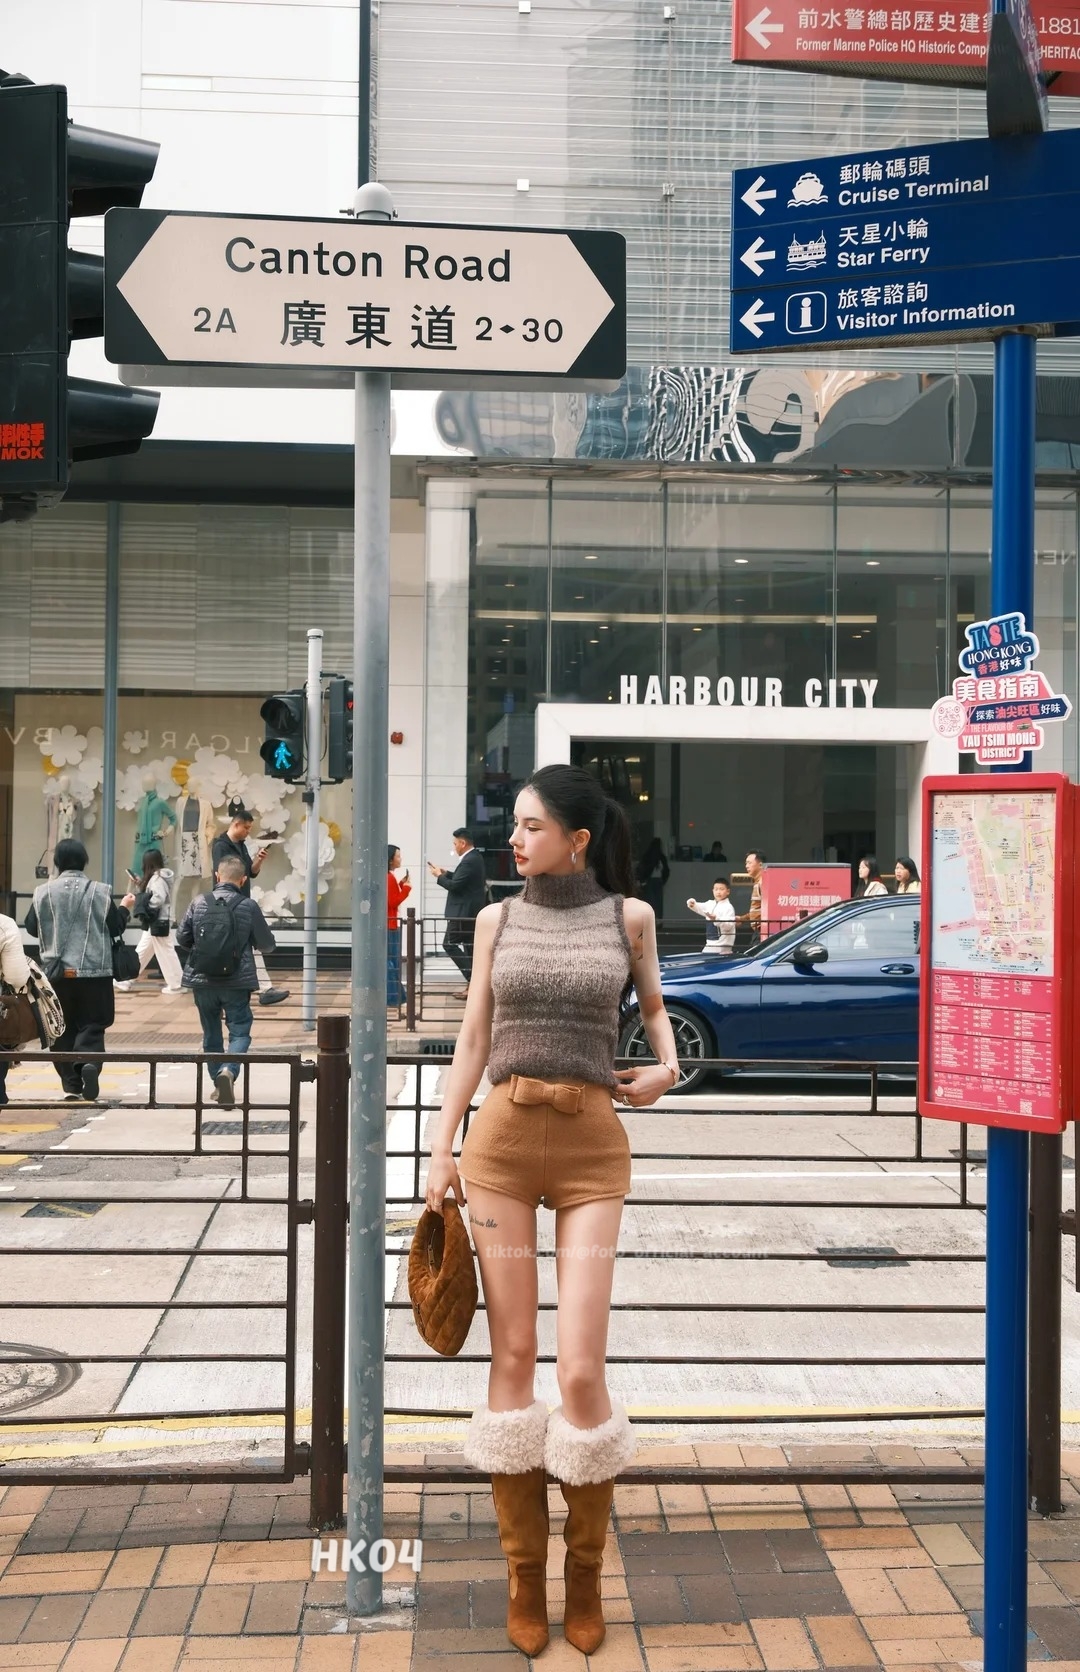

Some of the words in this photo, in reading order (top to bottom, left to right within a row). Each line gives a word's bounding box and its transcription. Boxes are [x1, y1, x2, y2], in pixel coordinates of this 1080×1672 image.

[1038, 16, 1080, 36] 1881
[796, 37, 831, 51] Former
[833, 38, 866, 52] Marine
[868, 38, 899, 53] Police
[900, 39, 916, 54] HQ
[918, 40, 955, 55] Historic
[839, 155, 931, 185] 郵輪碼頭
[838, 187, 900, 206] Cruise
[904, 175, 990, 199] Terminal
[838, 217, 929, 247] 天星小輪
[225, 236, 383, 278] Canton
[404, 244, 511, 282] Road
[837, 250, 875, 268] Star
[880, 246, 931, 264] Ferry
[837, 281, 929, 310] 旅客諮詢
[193, 306, 238, 334] 2A
[279, 299, 458, 351] 廣東道
[836, 312, 898, 331] Visitor
[903, 301, 1016, 325] Information
[1, 447, 45, 460] MOK
[971, 619, 1022, 650] TASTE
[967, 648, 1000, 665] HONG
[1000, 641, 1032, 659] KONG
[977, 656, 1022, 675] 香港好味
[620, 674, 784, 707] HARBOUR
[804, 678, 879, 708] CITY
[955, 675, 1039, 703] 美食指南
[962, 735, 980, 747] YAU
[981, 733, 1006, 746] TSIM
[1007, 731, 1036, 745] MONG
[981, 747, 1016, 758] DISTRICT
